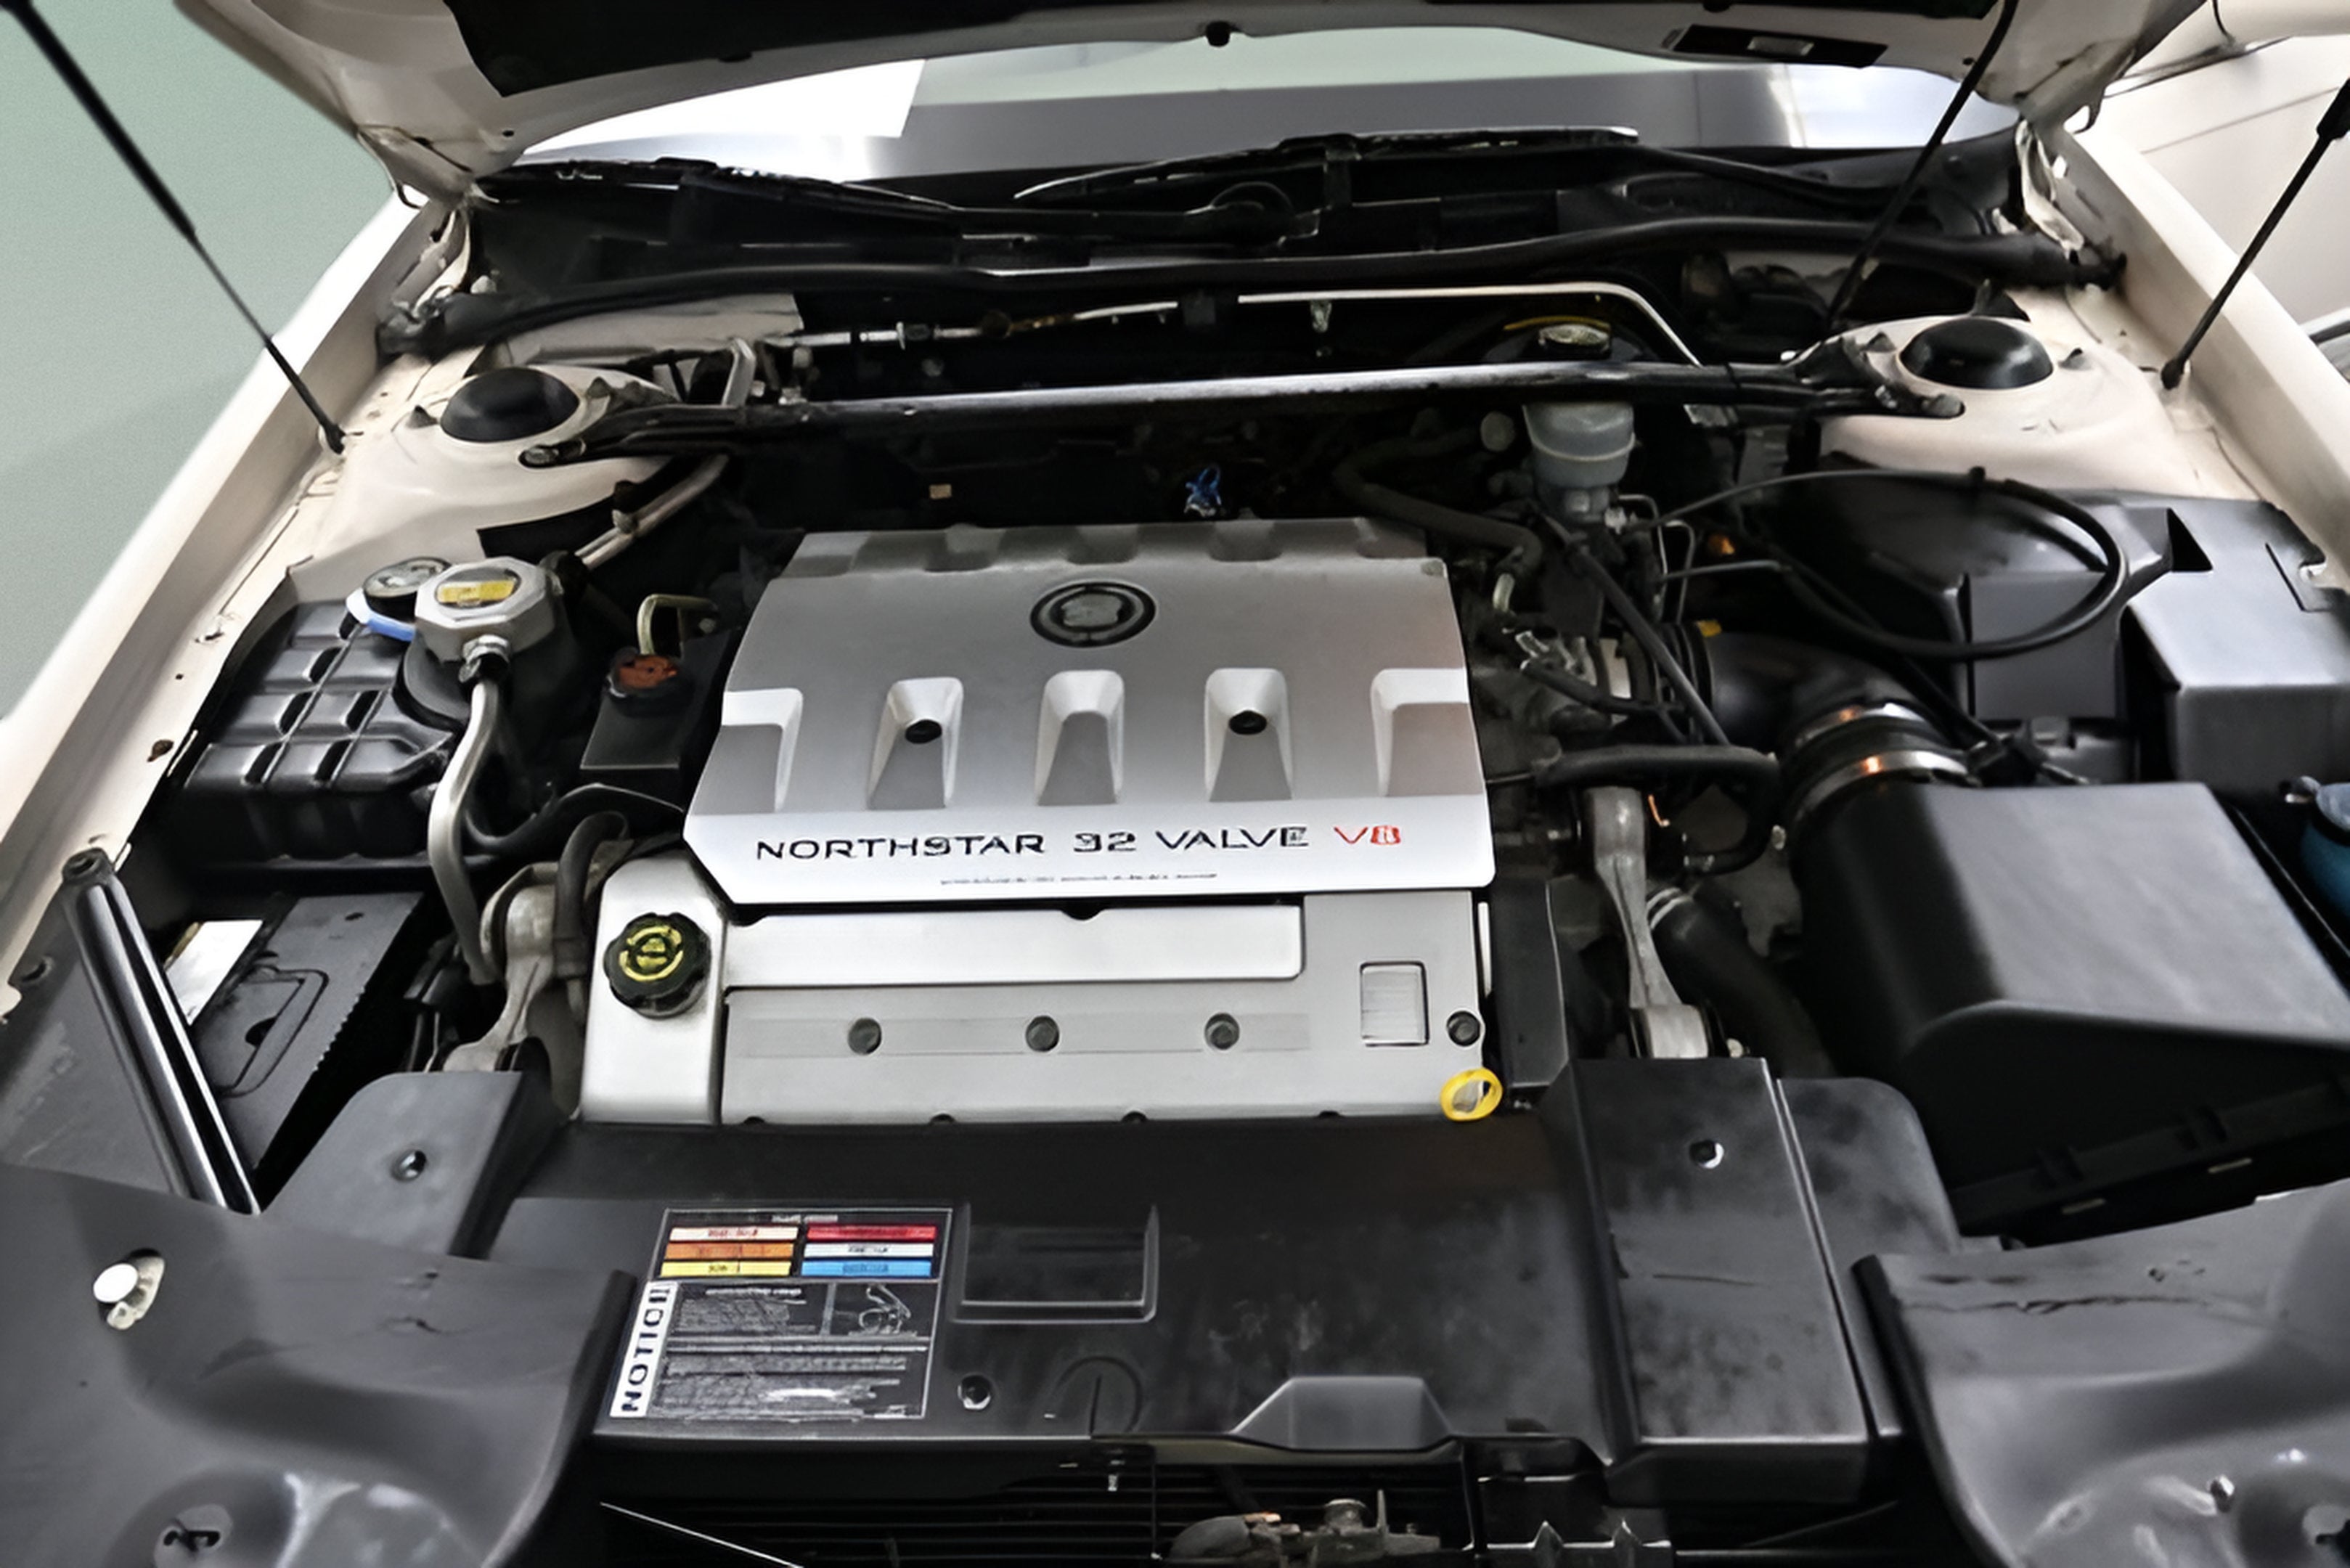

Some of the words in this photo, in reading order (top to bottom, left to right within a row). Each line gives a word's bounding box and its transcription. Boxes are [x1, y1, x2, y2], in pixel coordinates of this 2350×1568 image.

[756, 835, 1045, 860] NORTHSTAR
[1073, 831, 1137, 853] 32
[1155, 826, 1309, 850] VALVE
[1333, 825, 1401, 846] V8
